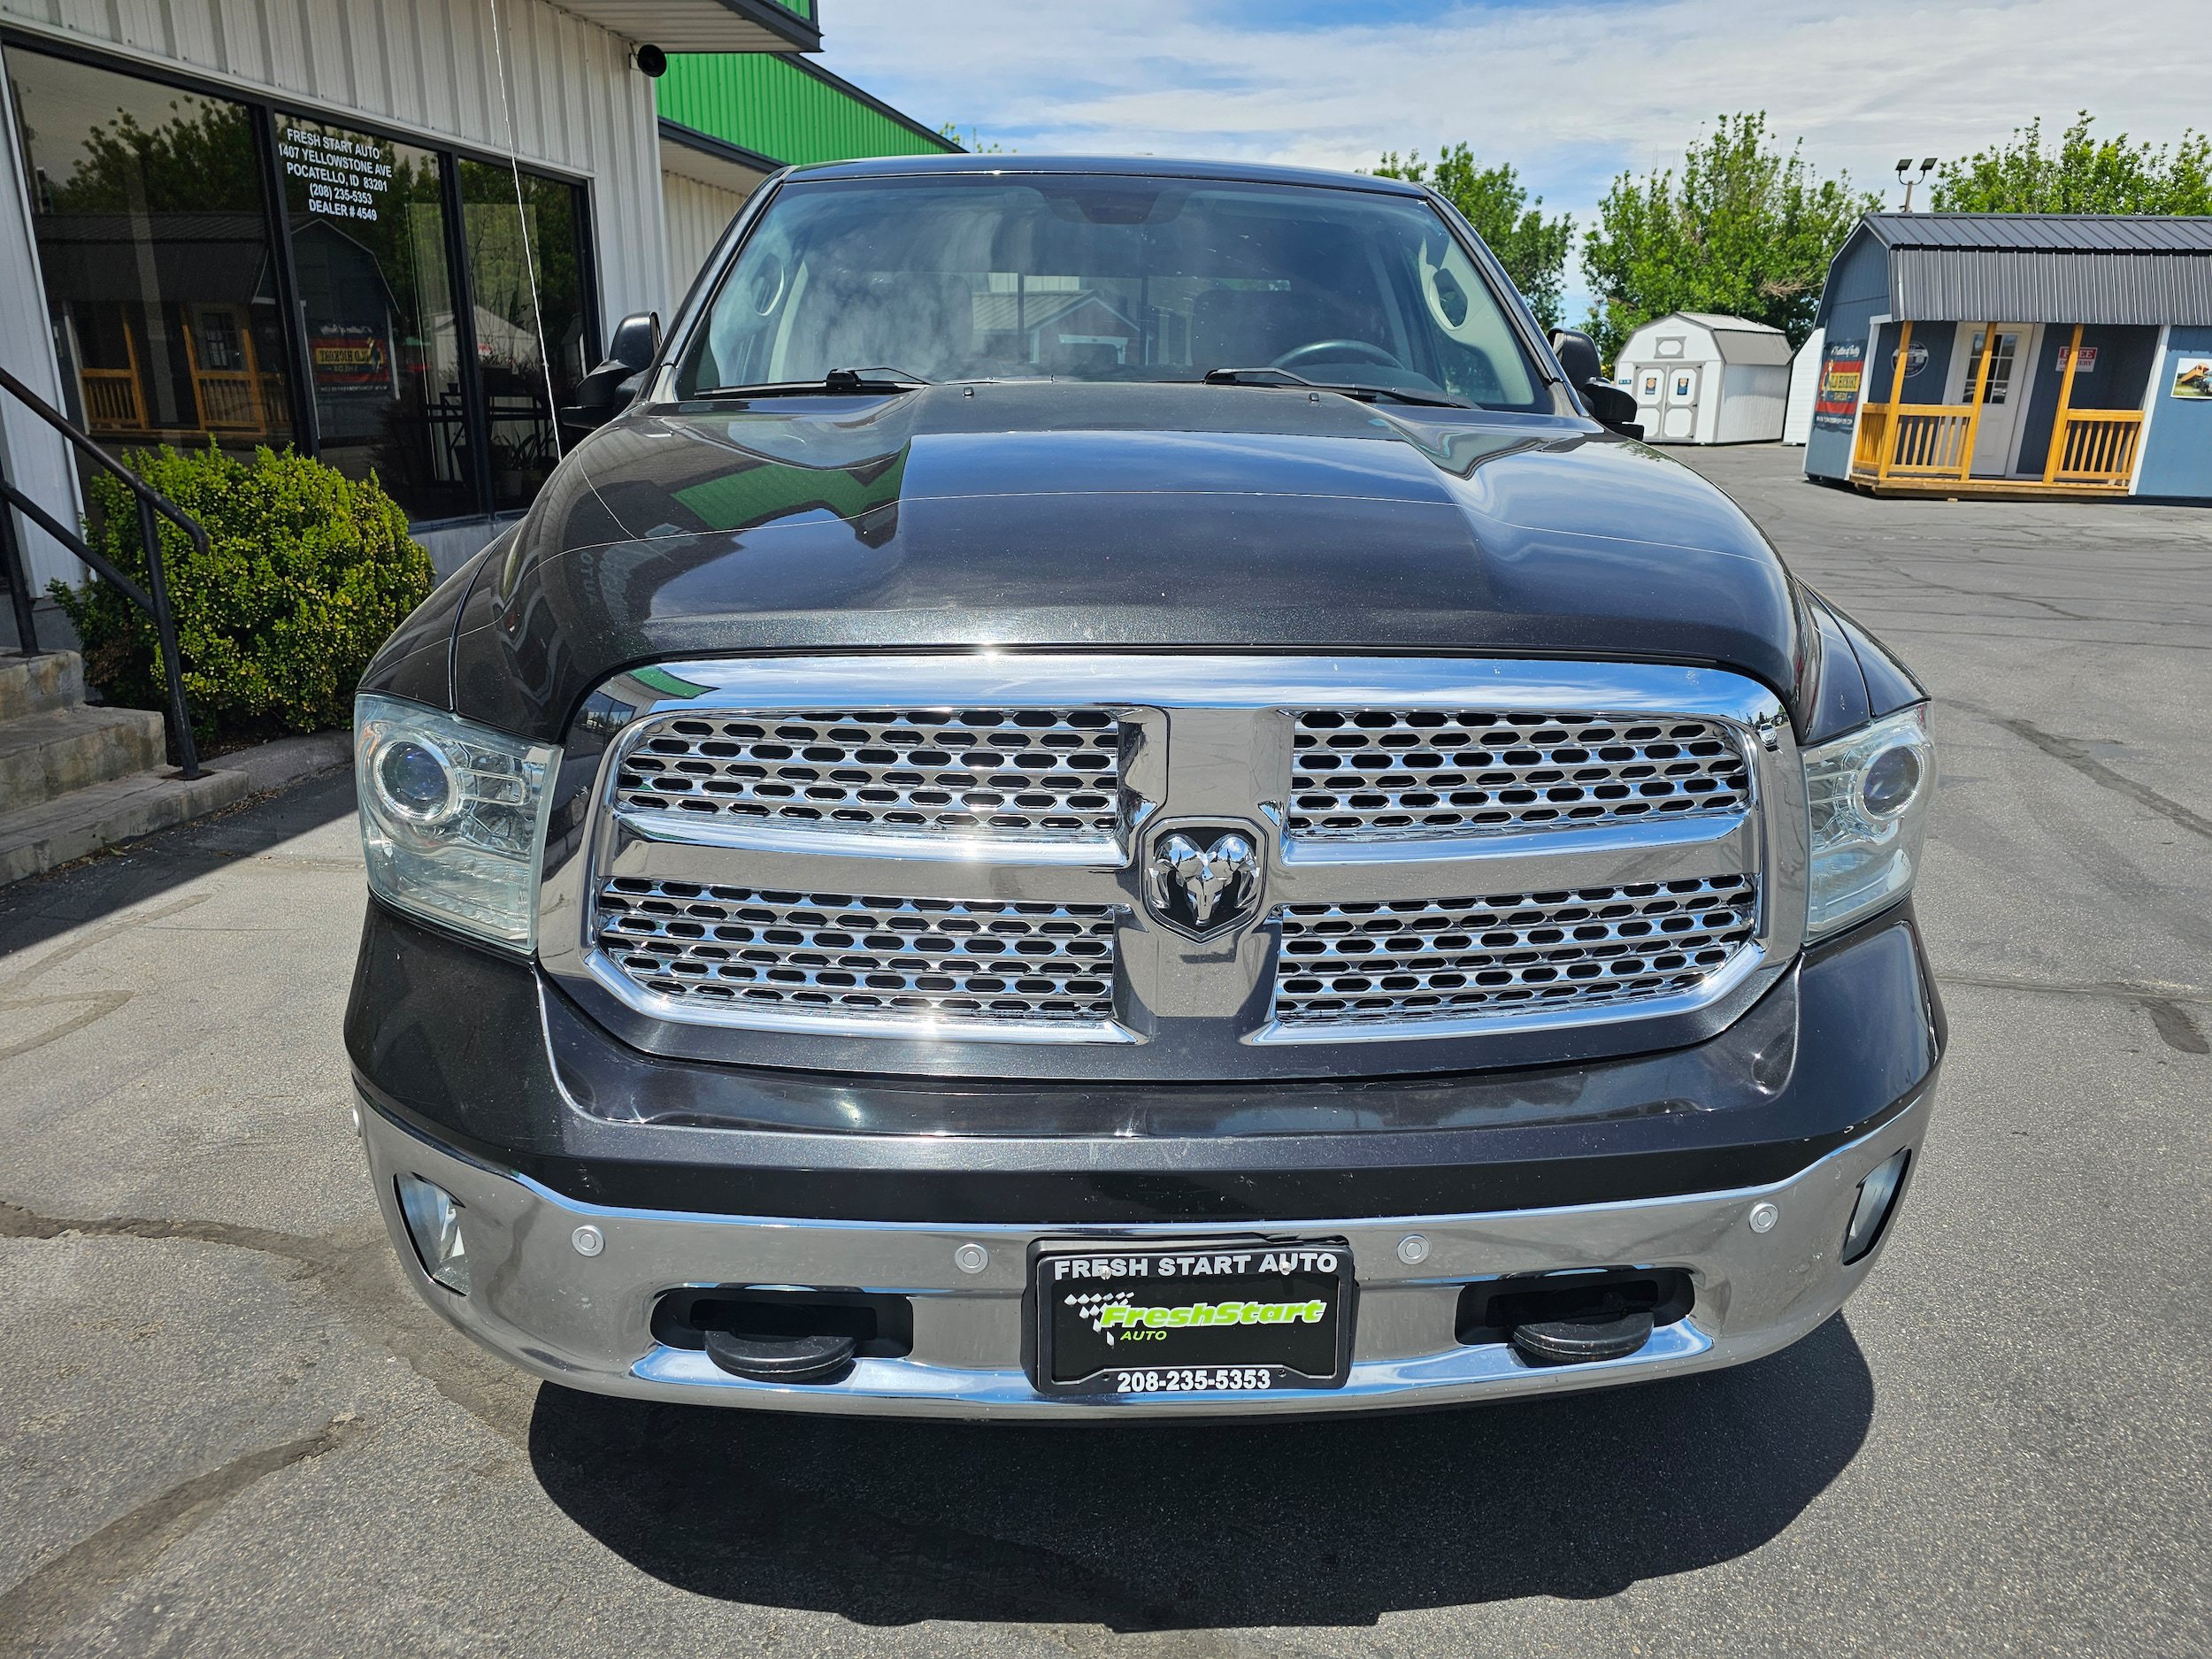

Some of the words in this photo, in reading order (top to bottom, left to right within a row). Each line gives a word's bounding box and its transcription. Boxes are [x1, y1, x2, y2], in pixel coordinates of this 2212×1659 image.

[287, 127, 321, 147] FRESH
[323, 136, 353, 154] START
[355, 143, 380, 159] AUTO
[278, 143, 300, 159] 1407
[301, 149, 373, 174] YELLOWSTONE
[374, 164, 392, 178] AVE
[287, 162, 349, 187] POCATELLO,
[349, 174, 359, 187] ID
[363, 177, 388, 192] 83201
[310, 182, 333, 201] (208)
[334, 188, 373, 205] 235-5353
[309, 198, 348, 217] DEALER
[357, 208, 378, 221] 4549
[2062, 349, 2093, 358] FEE
[1054, 1258, 1148, 1280] FRESH
[1158, 1254, 1251, 1277] START
[1259, 1252, 1338, 1274] AUTO
[1100, 1299, 1327, 1328] FreshStart
[1119, 1330, 1168, 1341] AUTO
[1117, 1369, 1271, 1393] 208-235-5353
